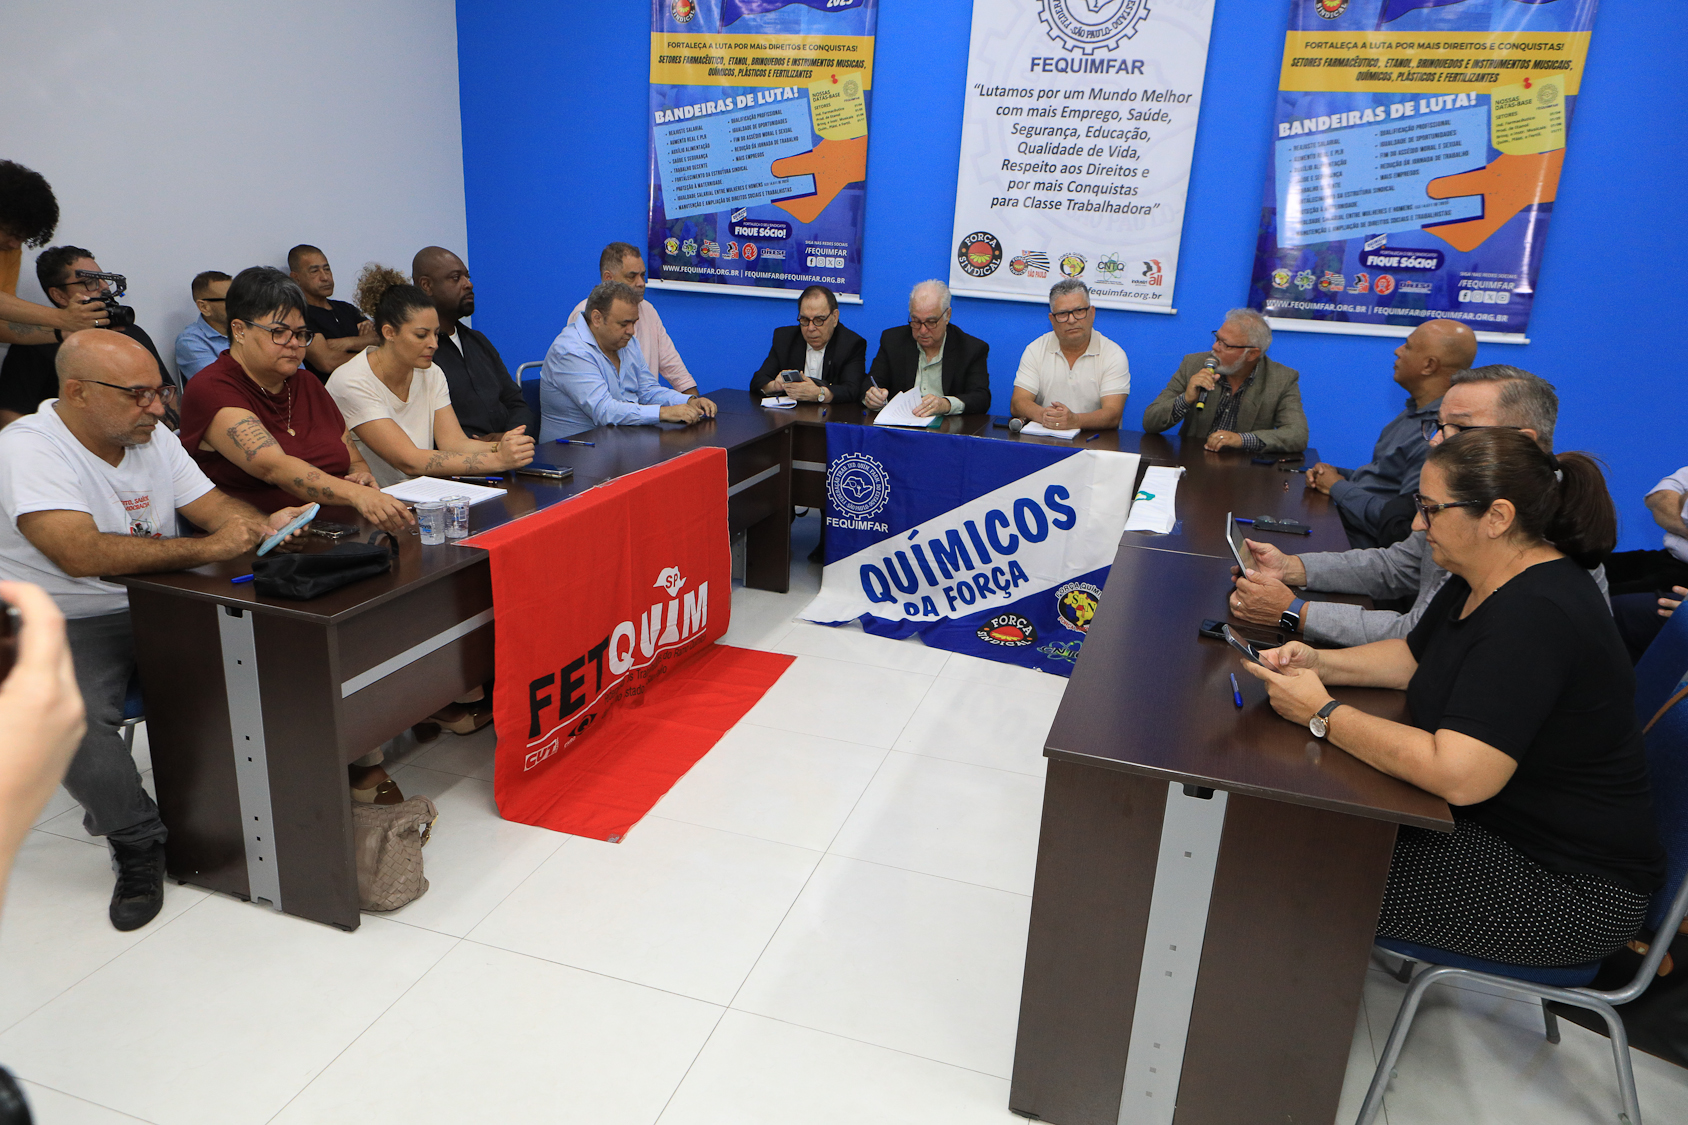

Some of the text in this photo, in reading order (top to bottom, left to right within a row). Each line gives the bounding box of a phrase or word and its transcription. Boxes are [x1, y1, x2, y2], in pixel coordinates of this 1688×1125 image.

[672, 8, 696, 23] SINDICAL
[1315, 2, 1347, 19] SINDICAL
[668, 41, 707, 50] FORTALEÇA
[809, 44, 858, 52] CONQUISTAS!
[1304, 41, 1359, 51] FORTALEÇA
[1370, 42, 1393, 50] LUTA
[1395, 42, 1415, 50] POR
[1416, 42, 1441, 50] MAIS
[1442, 42, 1488, 50] DIREITOS
[1490, 42, 1495, 50] E
[1497, 43, 1565, 52] CONQUISTAS!
[658, 54, 867, 69] SETORES FARMACÊUTICO, ETANOL, BRINQUEDOS E INSTRUMENTOS MUSICAIS,
[1030, 56, 1145, 75] FEQUIMFAR
[1291, 55, 1573, 71] SETORES FARMACÊUTICO, ETANOL, BRINQUEDOS E INSTRUMENTOS MUSICAIS,
[708, 67, 813, 79] QUÍMICOS, PLÁSTICOS E FERTILIZANTES
[1355, 70, 1500, 83] QUÍMICOS, PLÁSTICOS E FERTILIZANTES
[812, 92, 841, 102] DATAS-BASE
[973, 83, 1193, 104] “Lutamos por um Mundo Melhor
[1495, 95, 1519, 105] NOSSAS
[655, 85, 799, 124] BANDEIRAS DE LUTA!
[1495, 98, 1532, 111] DATAS-BASE
[996, 104, 1172, 125] com mais Emprego, Saúde,
[1278, 90, 1478, 138] BANDEIRAS DE LUTA!
[1011, 122, 1151, 143] Segurança, Educação,
[1017, 141, 1141, 161] Qualidade de Vida,
[1001, 158, 1150, 178] Respeito aos Direitos e
[1007, 179, 1139, 197] por mais Conquistas
[990, 196, 1161, 216] para Classe Trabalhadora”
[734, 226, 787, 239] FIQUE SÓCIO!
[964, 233, 998, 248] FORÇA
[804, 247, 848, 257] /FEQUIMFAR
[959, 255, 1001, 276] SINDICAL
[1097, 261, 1125, 272] CNTQ
[1366, 255, 1438, 270] FIQUE SÓCIO!
[662, 264, 740, 278] WWW.FEQUIMFAR.ORG.BR
[744, 270, 846, 285] FEQUIMFAR@FEQUIMFAR.ORG.BR
[1035, 271, 1048, 279] PAULO
[1149, 274, 1163, 286] all
[1457, 279, 1516, 290] /FEQUIMFAR
[1265, 299, 1367, 314] WWW.FEQUIMFAR.ORG.BR
[1373, 306, 1509, 322] FEQUIMFAR@FEQUIMFAR.ORG.BR
[826, 516, 889, 533] FEQUIMFAR
[859, 484, 1077, 605] QUÍMICOS
[665, 572, 679, 589] SP
[903, 560, 1030, 617] DA FORÇA
[1054, 581, 1080, 598] FORÇA
[990, 614, 1033, 636] FORÇA
[976, 631, 1032, 647] SINDICAL
[528, 580, 708, 740] FETQUIM
